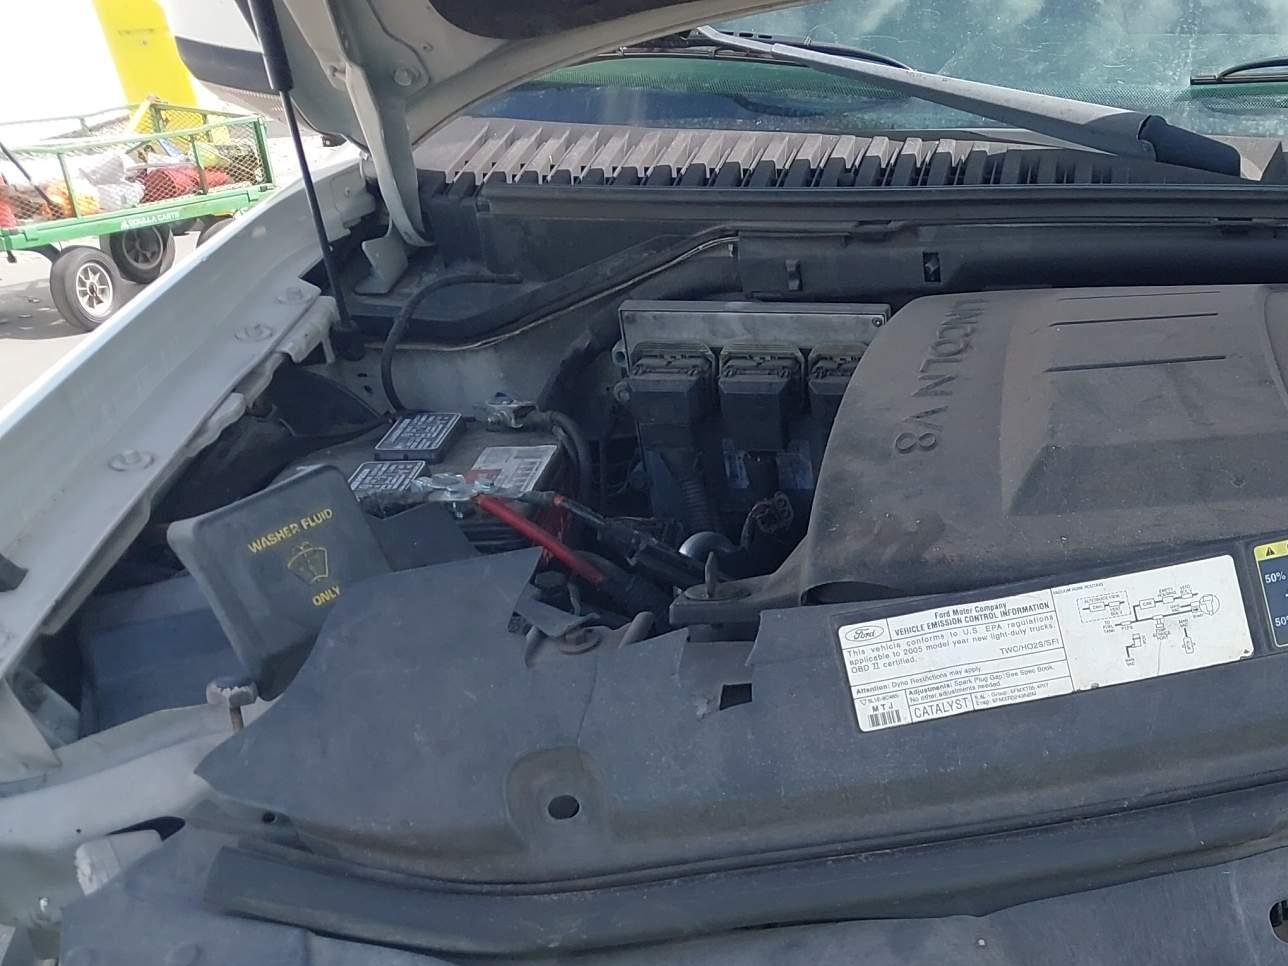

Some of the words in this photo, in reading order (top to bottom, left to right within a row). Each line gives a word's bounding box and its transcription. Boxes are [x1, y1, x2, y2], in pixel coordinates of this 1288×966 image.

[894, 405, 949, 454] V8
[248, 523, 301, 553] WASHER
[300, 508, 333, 530] FLUID
[1264, 570, 1286, 584] 50%
[312, 585, 341, 606] ONLY
[894, 624, 925, 637] VEHICLE
[926, 616, 962, 630] EMISSION
[964, 610, 998, 624] CONTROL
[999, 600, 1050, 618] INFORMATION
[933, 609, 951, 620] Ford
[952, 605, 974, 617] Motor
[974, 600, 1007, 614] Company
[847, 647, 866, 657] This
[870, 640, 901, 653] vehicle
[905, 633, 944, 647] conforms
[949, 630, 958, 638] to
[985, 622, 1003, 632] EPA
[1006, 612, 1054, 630] regulations
[852, 625, 876, 640] Ford
[849, 651, 890, 666] applicable
[892, 649, 901, 658] to
[903, 645, 923, 656] 2005
[925, 640, 950, 651] model
[952, 638, 970, 648] year
[972, 634, 988, 643] new
[990, 626, 1027, 642] light-duty
[999, 637, 1059, 655] TWC/HO2S/SFI
[850, 663, 870, 674] OBD
[855, 682, 890, 694] Attention:
[891, 679, 908, 689] Dyno
[909, 670, 948, 685] Restrictions
[948, 669, 962, 677] may
[912, 694, 970, 718] CATALYST
